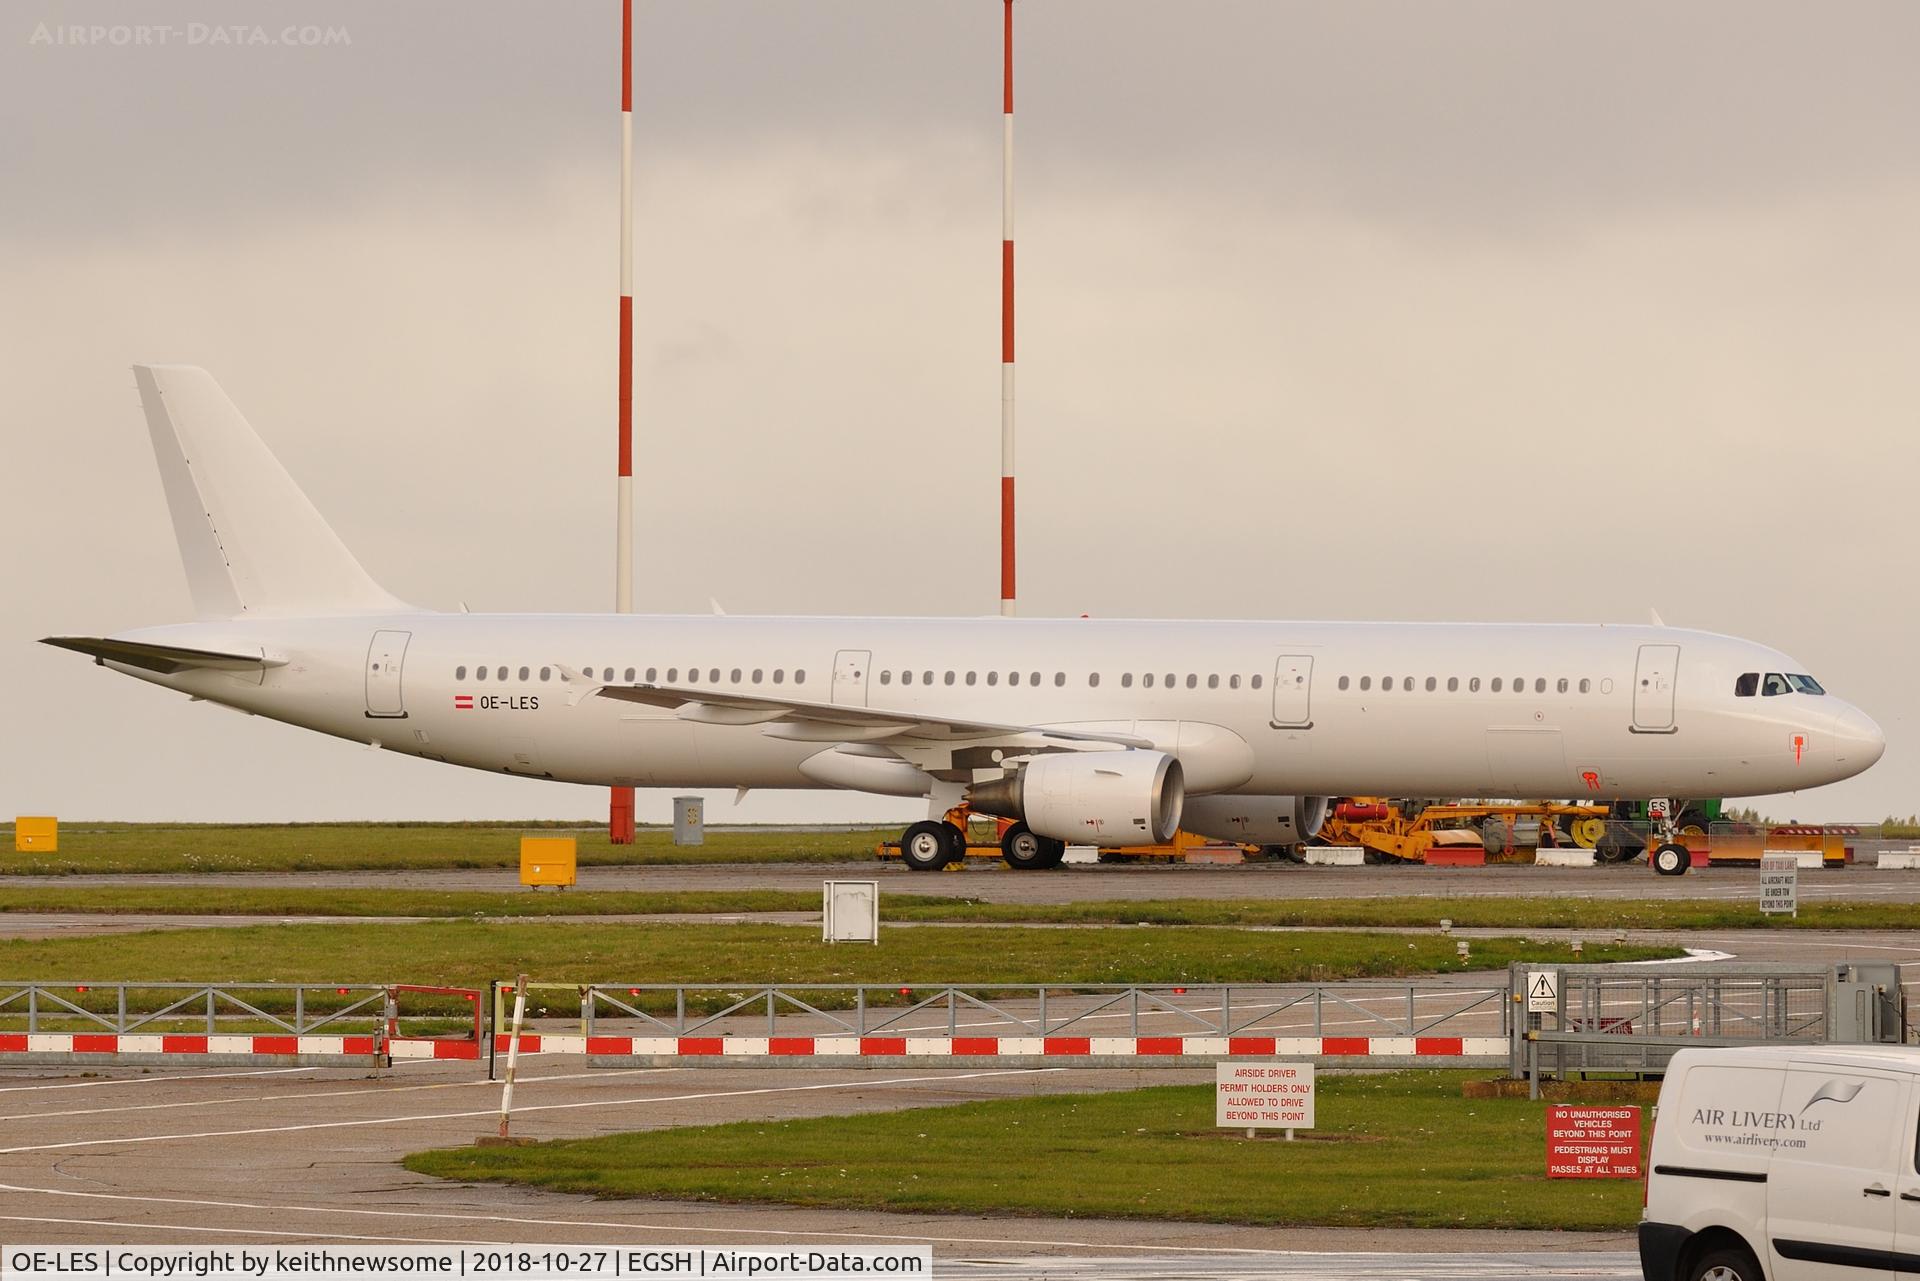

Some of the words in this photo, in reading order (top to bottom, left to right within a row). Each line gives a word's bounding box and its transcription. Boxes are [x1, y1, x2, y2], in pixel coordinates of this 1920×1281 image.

[480, 696, 539, 710] OE-LES
[1651, 802, 1667, 812] ES
[1235, 1069, 1264, 1078] AIRSIDE
[1268, 1070, 1296, 1078] DRIVER
[1220, 1084, 1248, 1092] PERMIT
[1252, 1084, 1288, 1093] HOLDERS
[1291, 1084, 1311, 1093] ONLY
[1228, 1098, 1264, 1106] ALLOWED
[1268, 1098, 1278, 1106] TO
[1282, 1098, 1304, 1107] DRIVE
[1226, 1112, 1258, 1120] BEYOND
[1261, 1112, 1278, 1120] THIS
[1282, 1112, 1304, 1120] POINT
[1692, 1109, 1724, 1125] AIR
[1732, 1111, 1796, 1130] LIVERY
[1801, 1120, 1821, 1131] Ltd
[1705, 1133, 1806, 1150] www.airlivery.com
